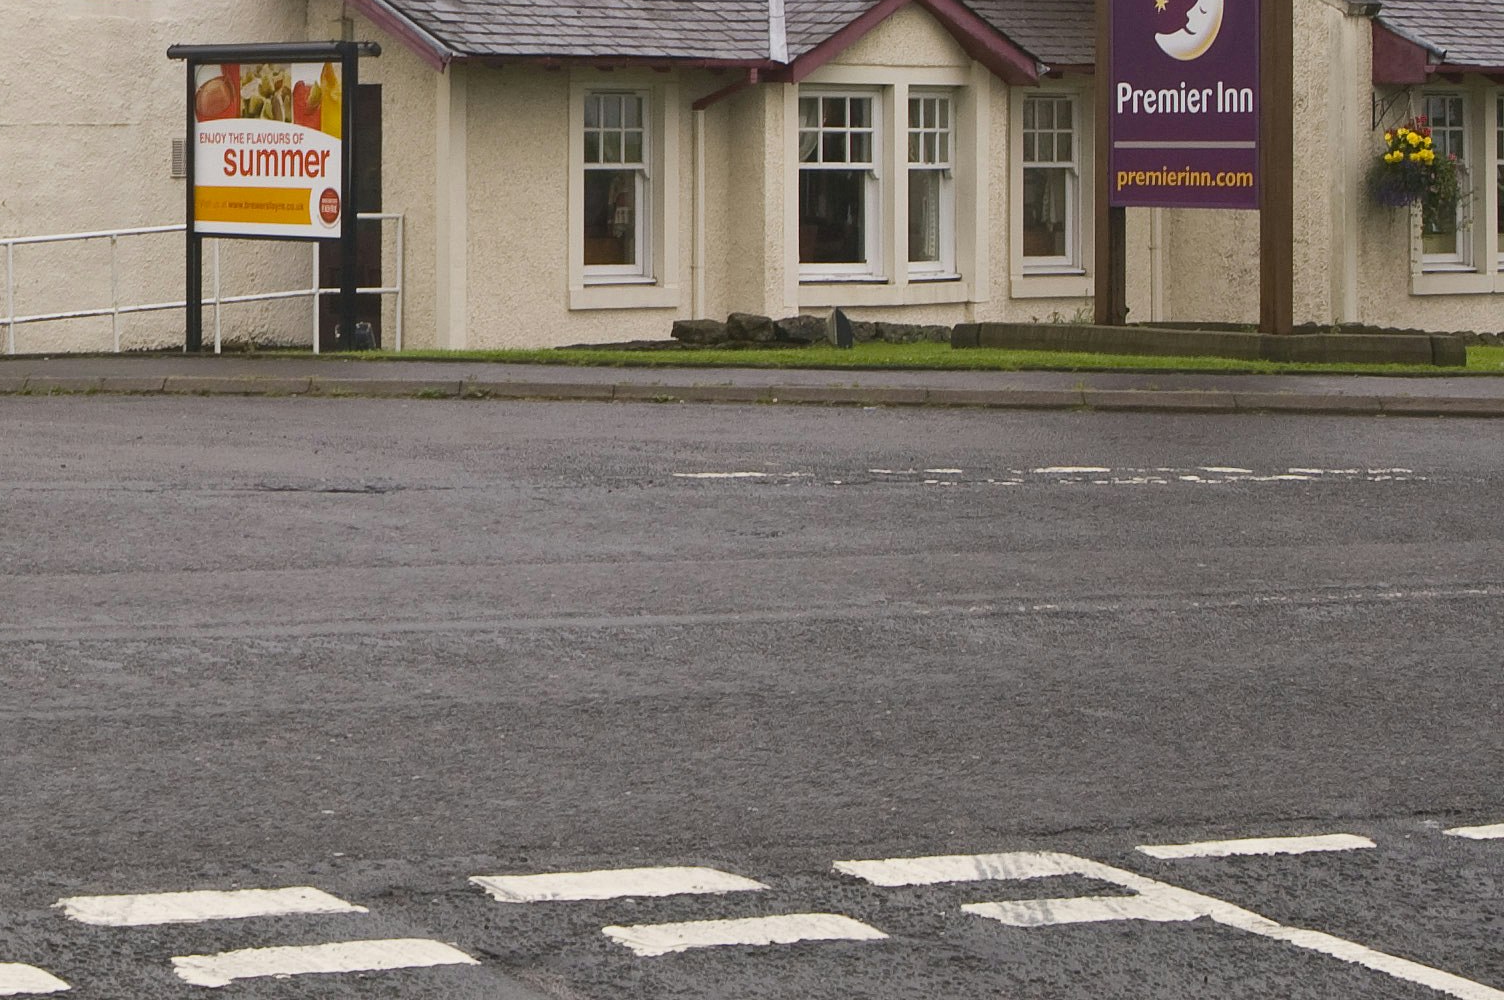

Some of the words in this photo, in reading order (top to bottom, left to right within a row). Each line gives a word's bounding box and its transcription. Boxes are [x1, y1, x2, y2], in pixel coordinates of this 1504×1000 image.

[1117, 81, 1212, 114] Premier
[1217, 81, 1253, 114] Inn
[199, 132, 226, 144] ENJOY
[228, 132, 244, 144] THE
[246, 132, 290, 144] FLAVOURS
[292, 133, 304, 145] OF
[223, 148, 330, 178] summer
[1117, 166, 1253, 192] premierinn.com
